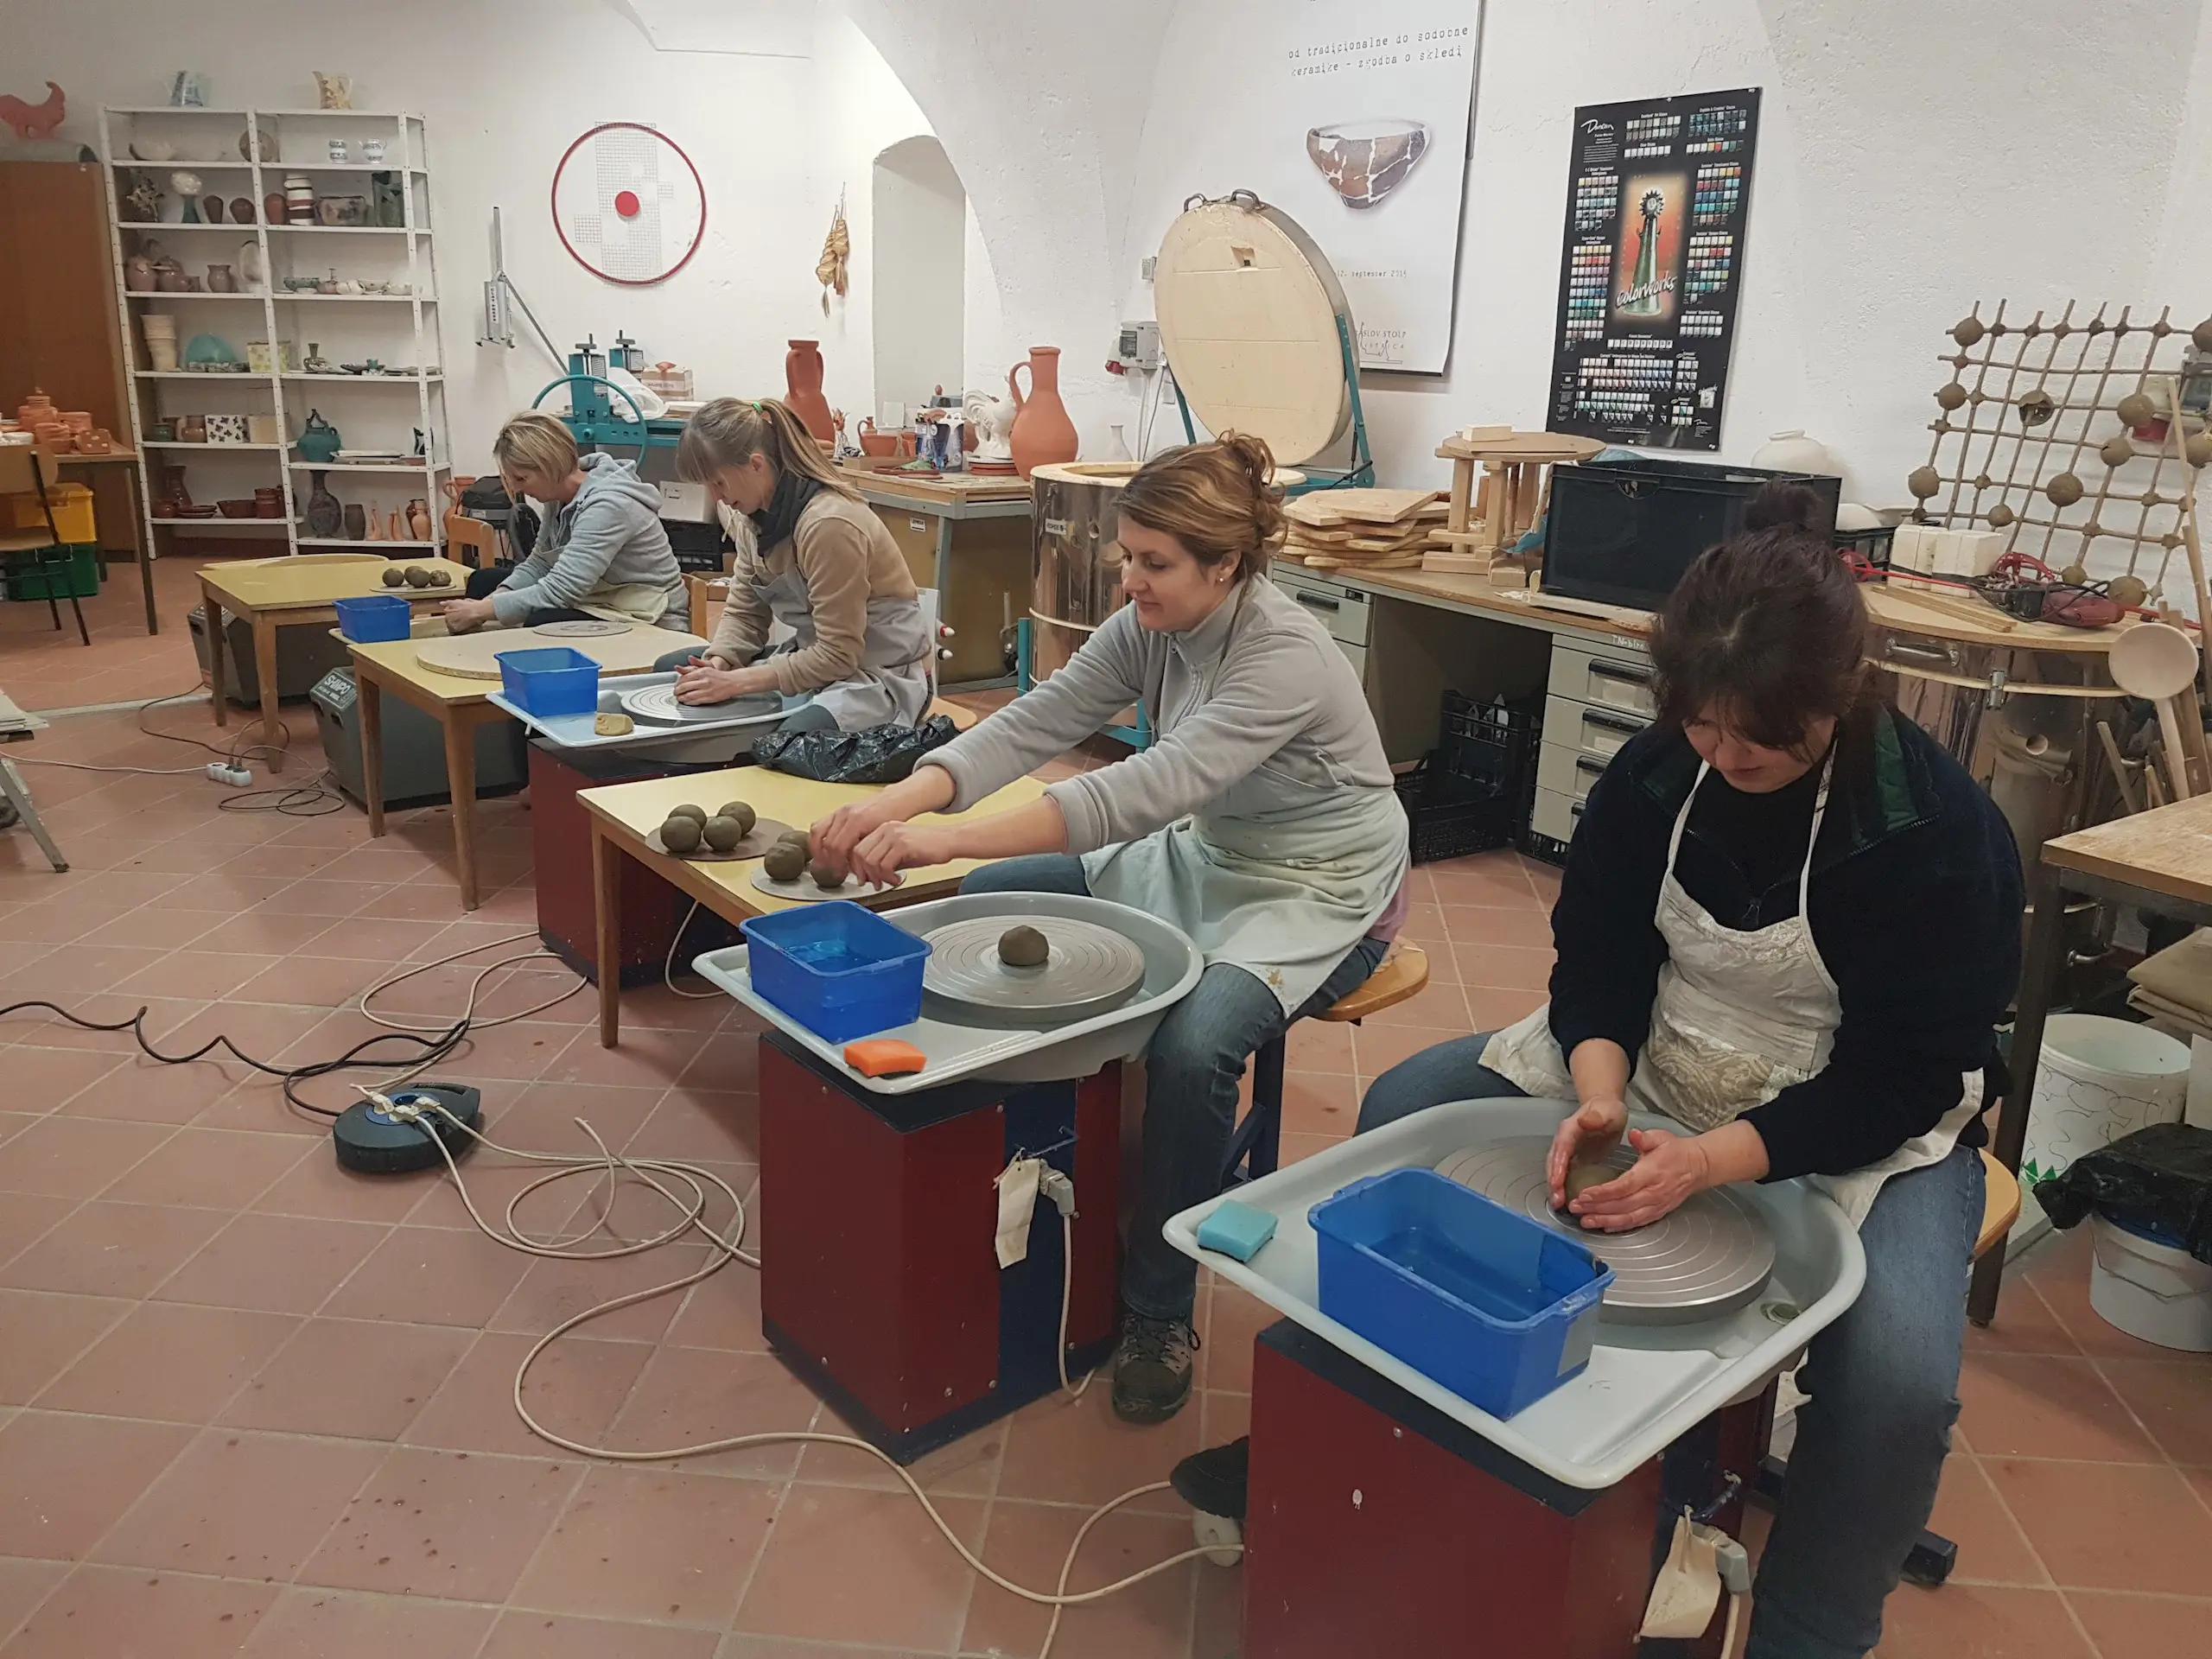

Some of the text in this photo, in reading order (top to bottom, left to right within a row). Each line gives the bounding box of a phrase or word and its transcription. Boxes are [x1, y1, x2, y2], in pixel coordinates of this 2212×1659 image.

[1288, 26, 1469, 59] od tradicionalne do sodobne
[1358, 54, 1397, 69] zgodba
[1419, 45, 1463, 61] skledi
